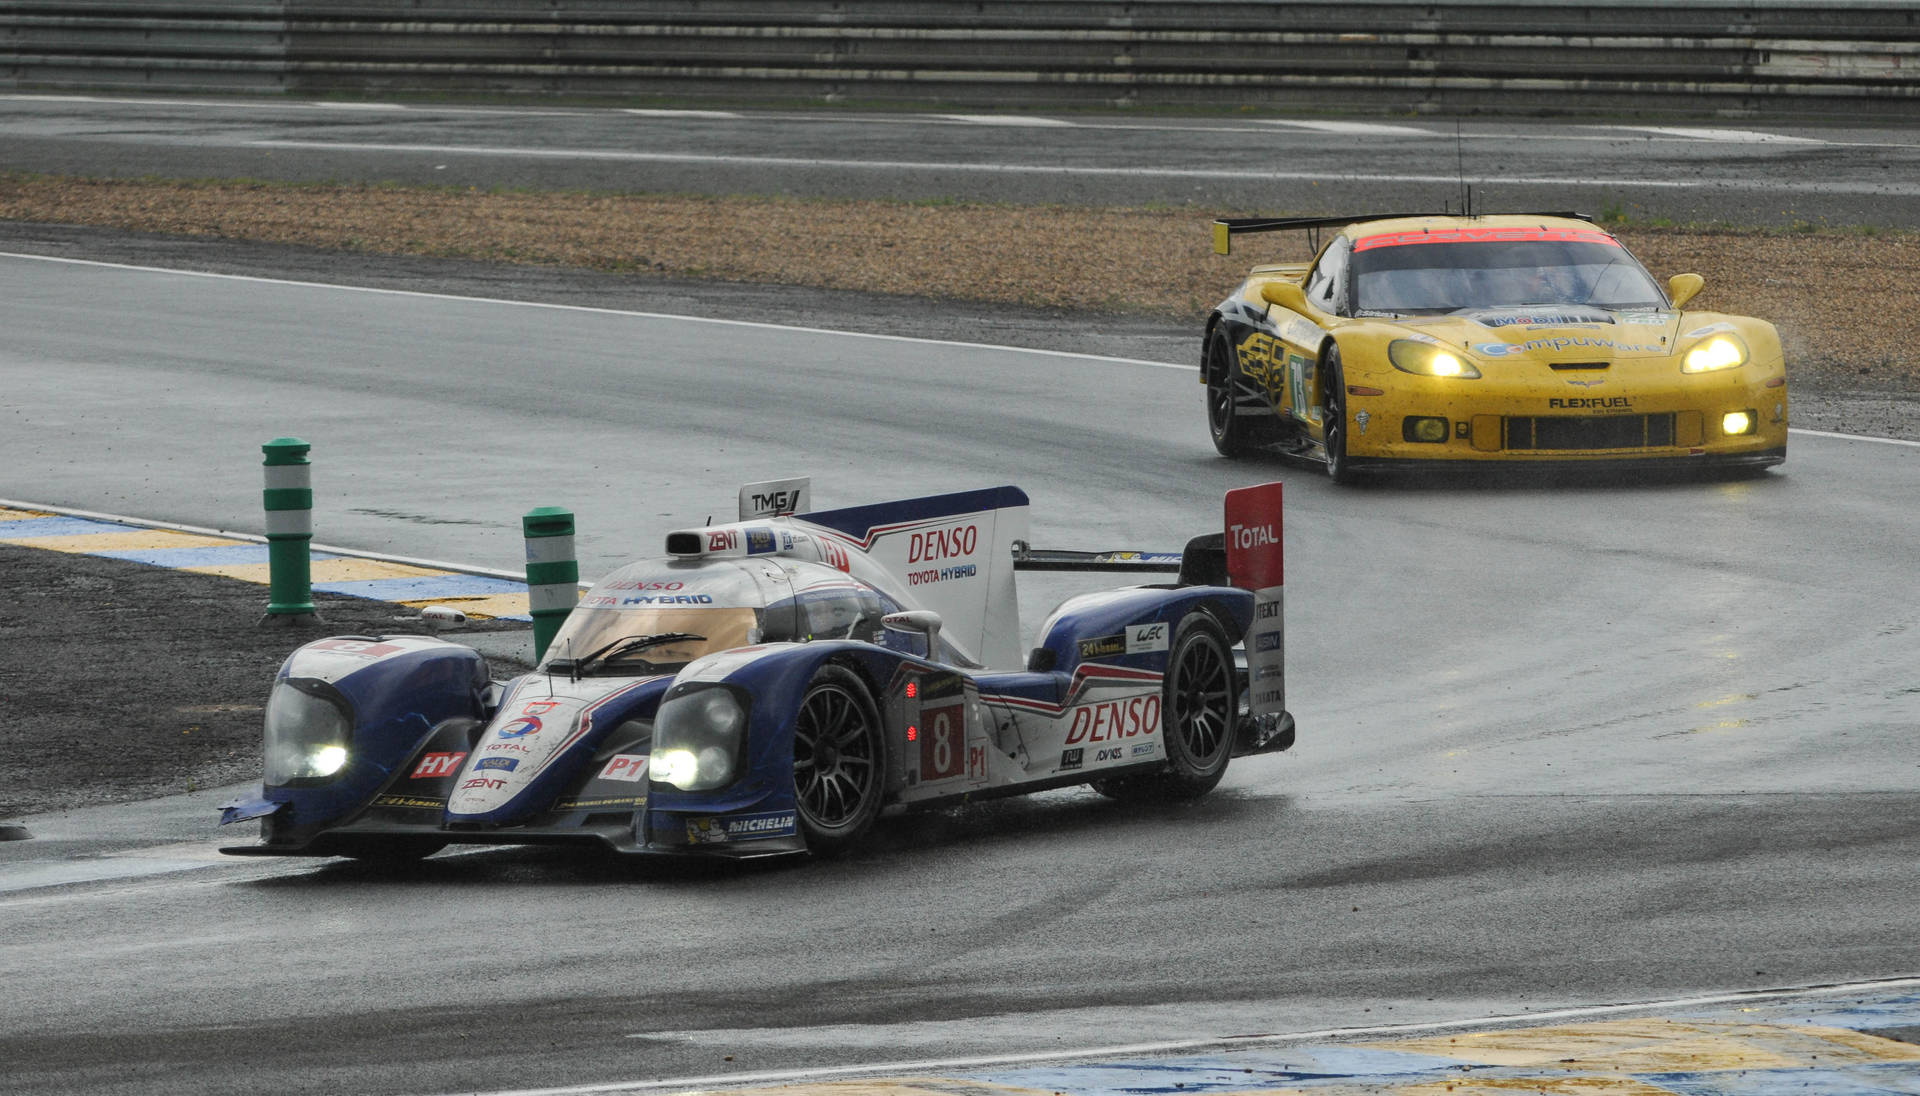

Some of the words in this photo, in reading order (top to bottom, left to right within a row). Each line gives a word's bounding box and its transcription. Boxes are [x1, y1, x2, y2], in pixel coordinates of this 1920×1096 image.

[1482, 336, 1662, 356] Compuware
[1549, 397, 1632, 409] FLEXFUEL
[752, 491, 788, 512] TMG
[706, 529, 739, 552] ZENT
[908, 525, 977, 564] DENSO
[1230, 523, 1279, 550] TOTAL
[908, 569, 940, 586] TOYOTA
[940, 563, 977, 582] HYBRID
[603, 581, 684, 591] DENSO
[622, 594, 713, 606] HYBRID
[1137, 625, 1164, 643] WEC
[1064, 695, 1160, 745] DENSO
[485, 743, 530, 753] TOTAL
[934, 712, 952, 774] 8
[415, 752, 463, 775] HY
[605, 758, 645, 778] P1
[969, 745, 985, 778] P1
[461, 778, 508, 791] ZENT
[728, 815, 795, 833] MICHELIN
